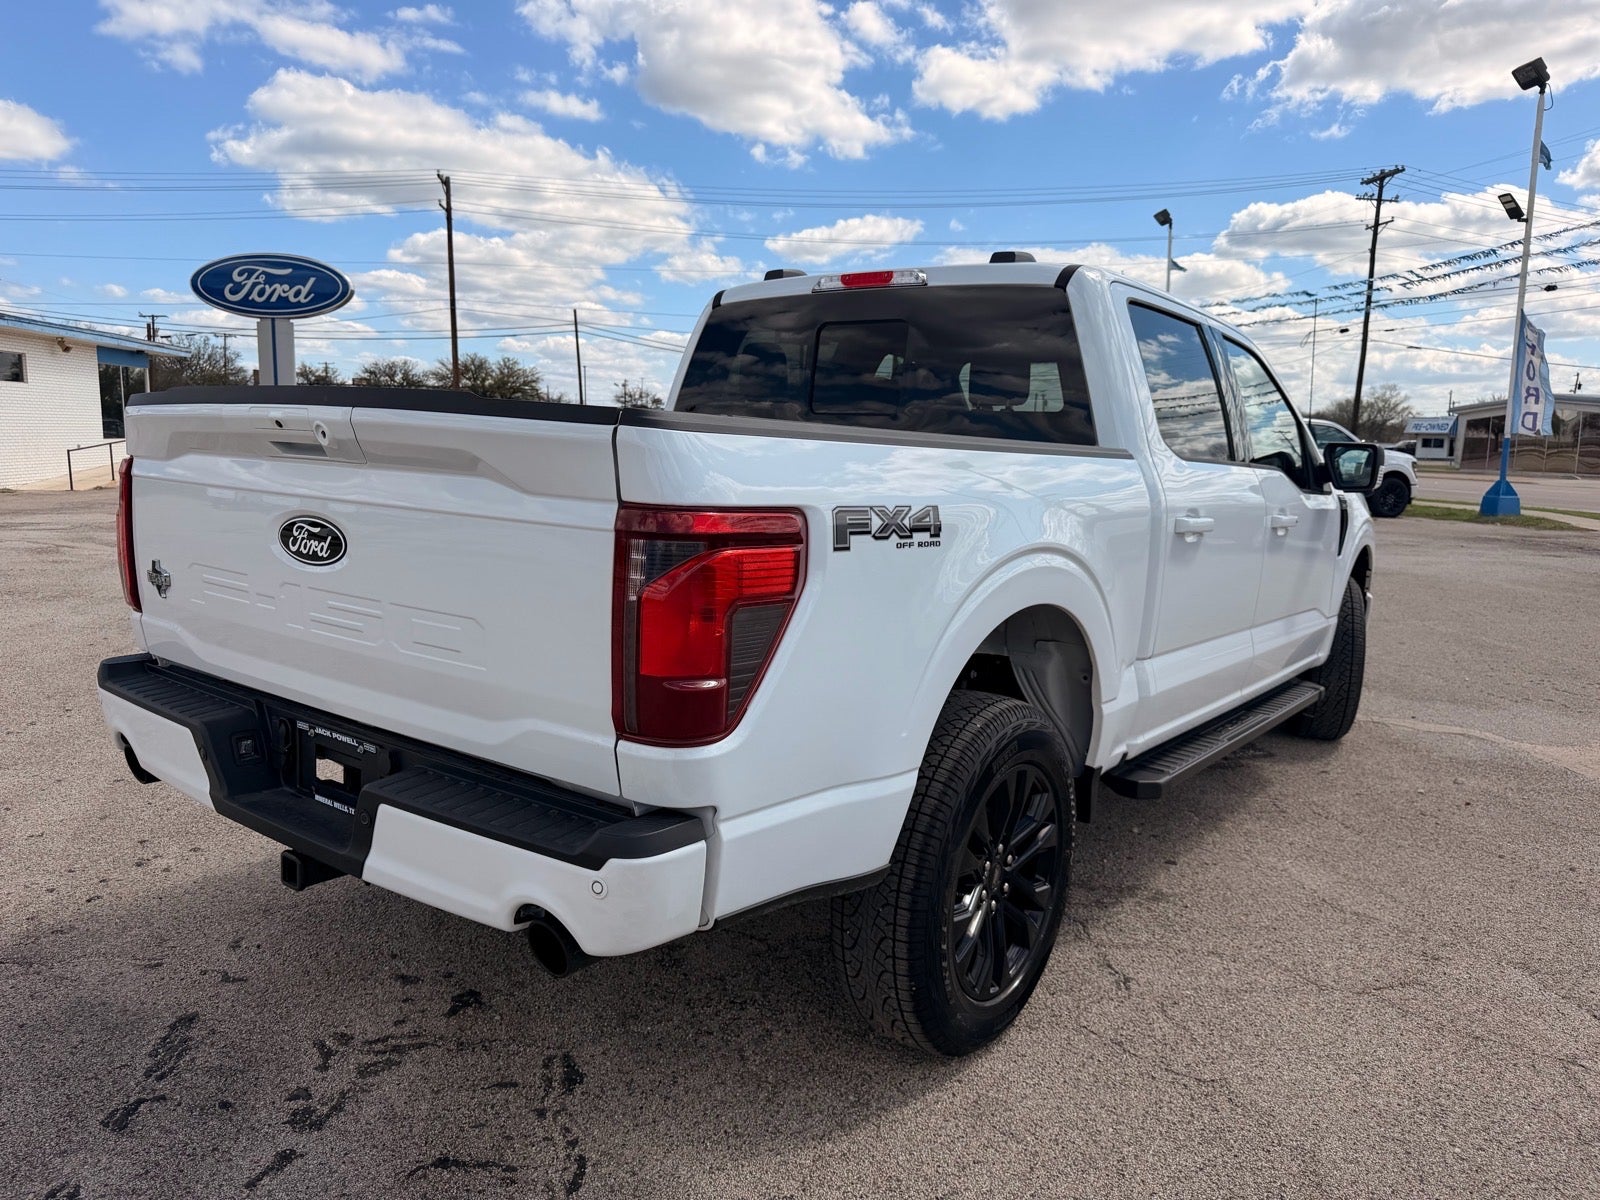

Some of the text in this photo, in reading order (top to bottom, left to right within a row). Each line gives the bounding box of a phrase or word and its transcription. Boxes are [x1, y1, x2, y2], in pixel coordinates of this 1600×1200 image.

[224, 265, 316, 304] Ford
[1412, 422, 1450, 431] PRE-OWNED
[832, 505, 942, 552] FX4
[288, 522, 332, 558] Ford
[896, 540, 941, 549] OFF ROAD
[314, 726, 359, 747] JACK POWELL
[314, 794, 334, 807] MINERAL
